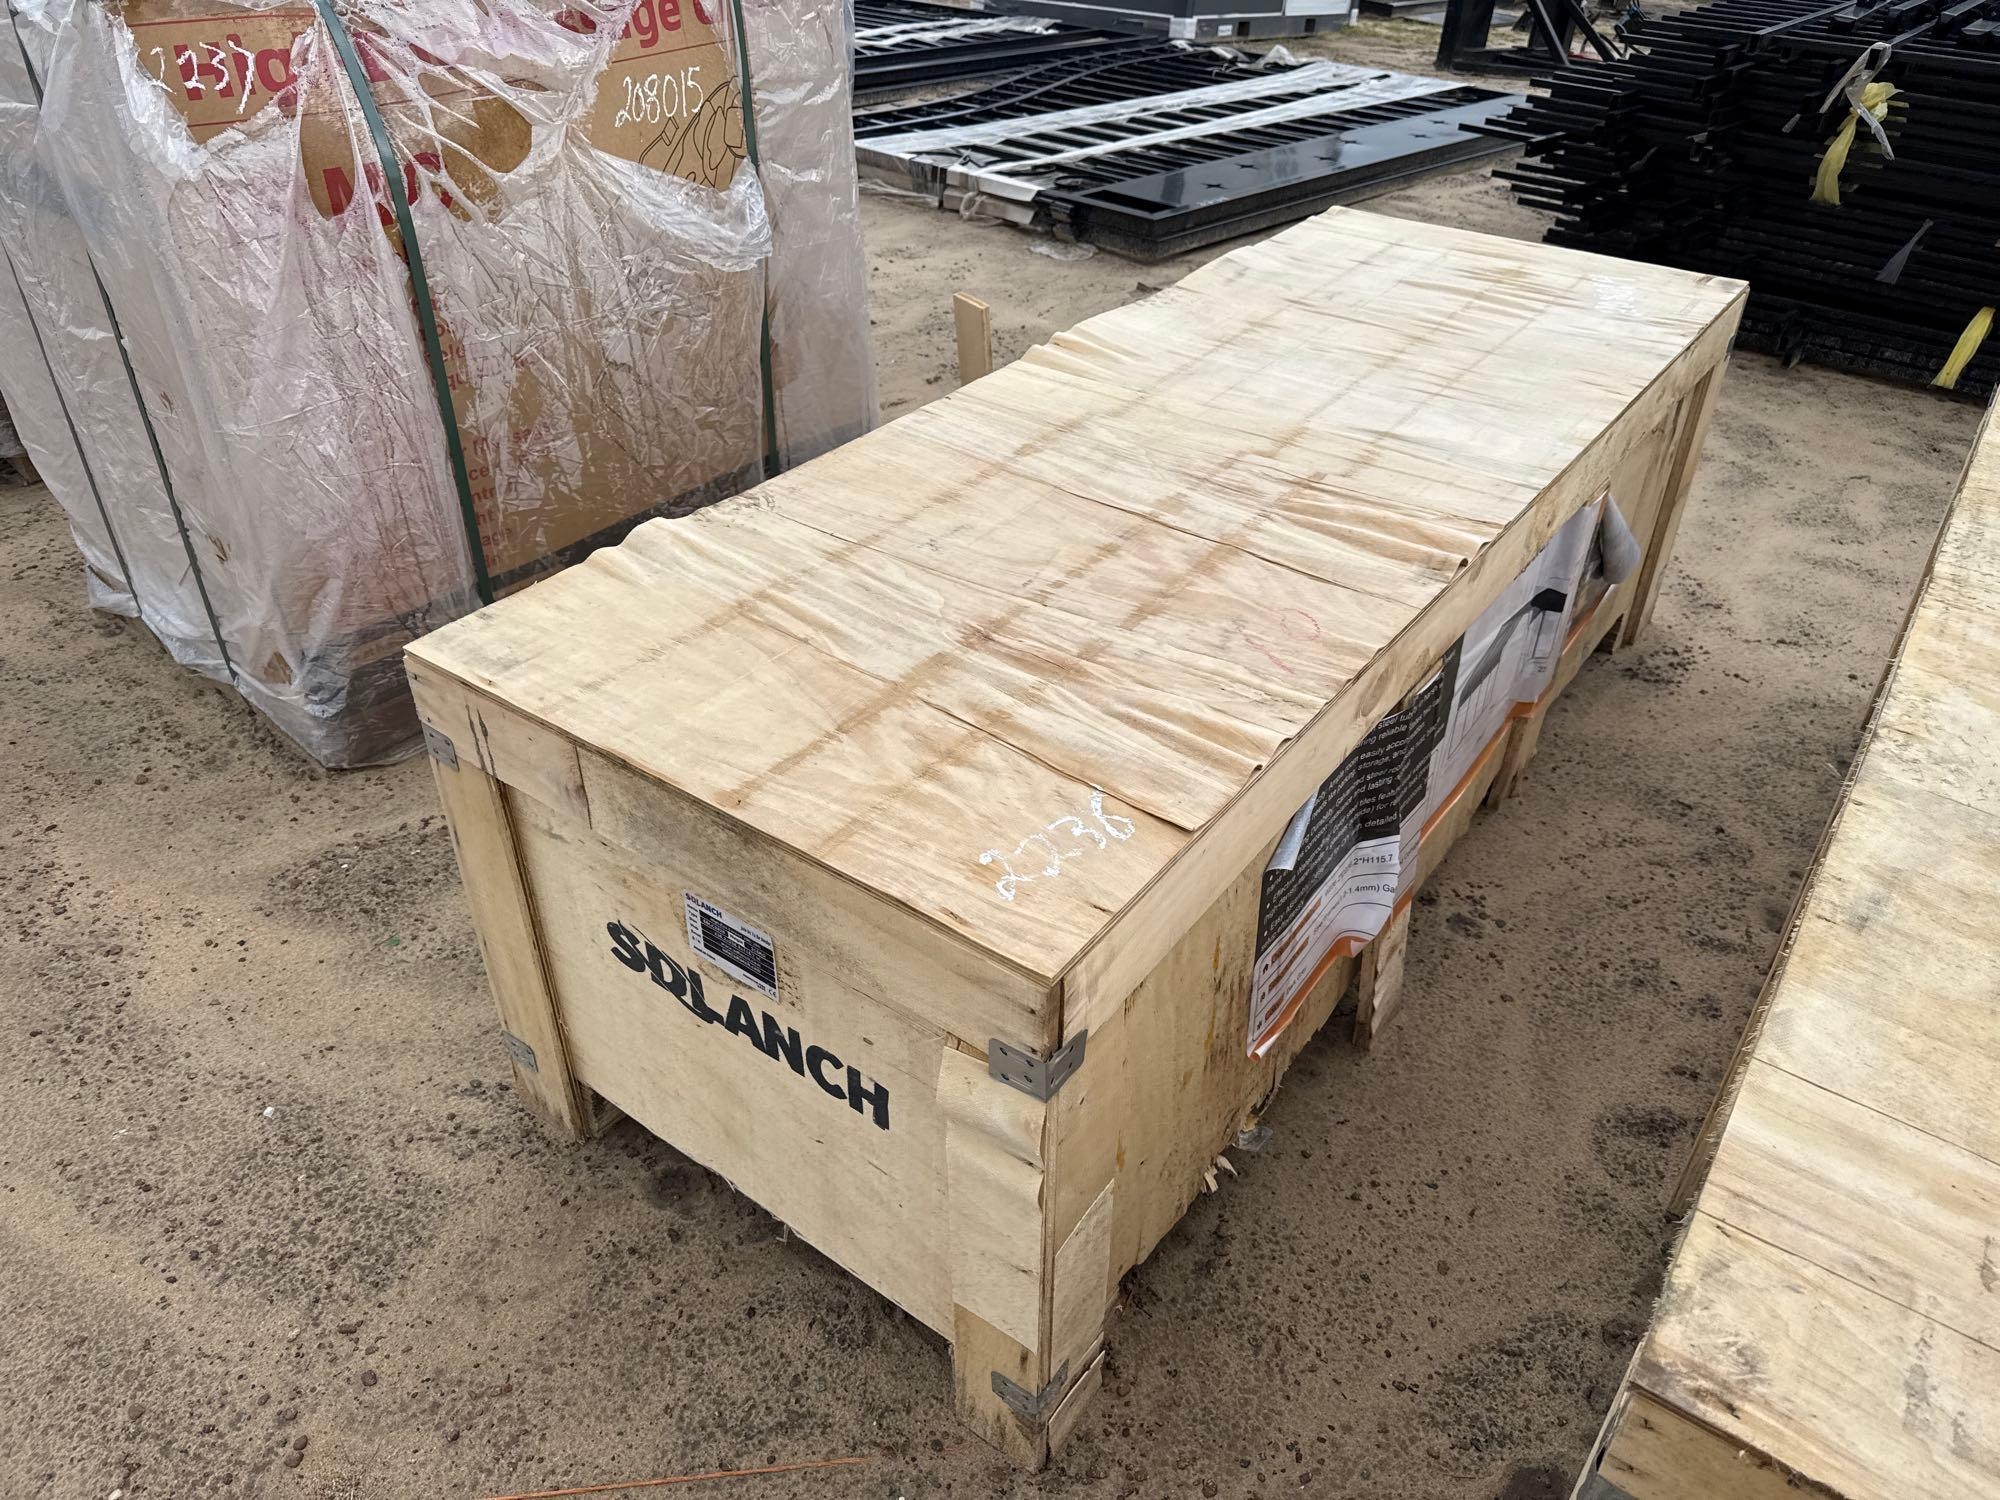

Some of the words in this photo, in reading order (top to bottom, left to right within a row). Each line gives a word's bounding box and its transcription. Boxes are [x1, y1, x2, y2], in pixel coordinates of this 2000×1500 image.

[614, 66, 704, 128] 208015
[1361, 746, 1385, 760] easily
[1367, 777, 1393, 791] lasting
[1365, 811, 1397, 827] detailed
[606, 920, 889, 1130] SDLANCH
